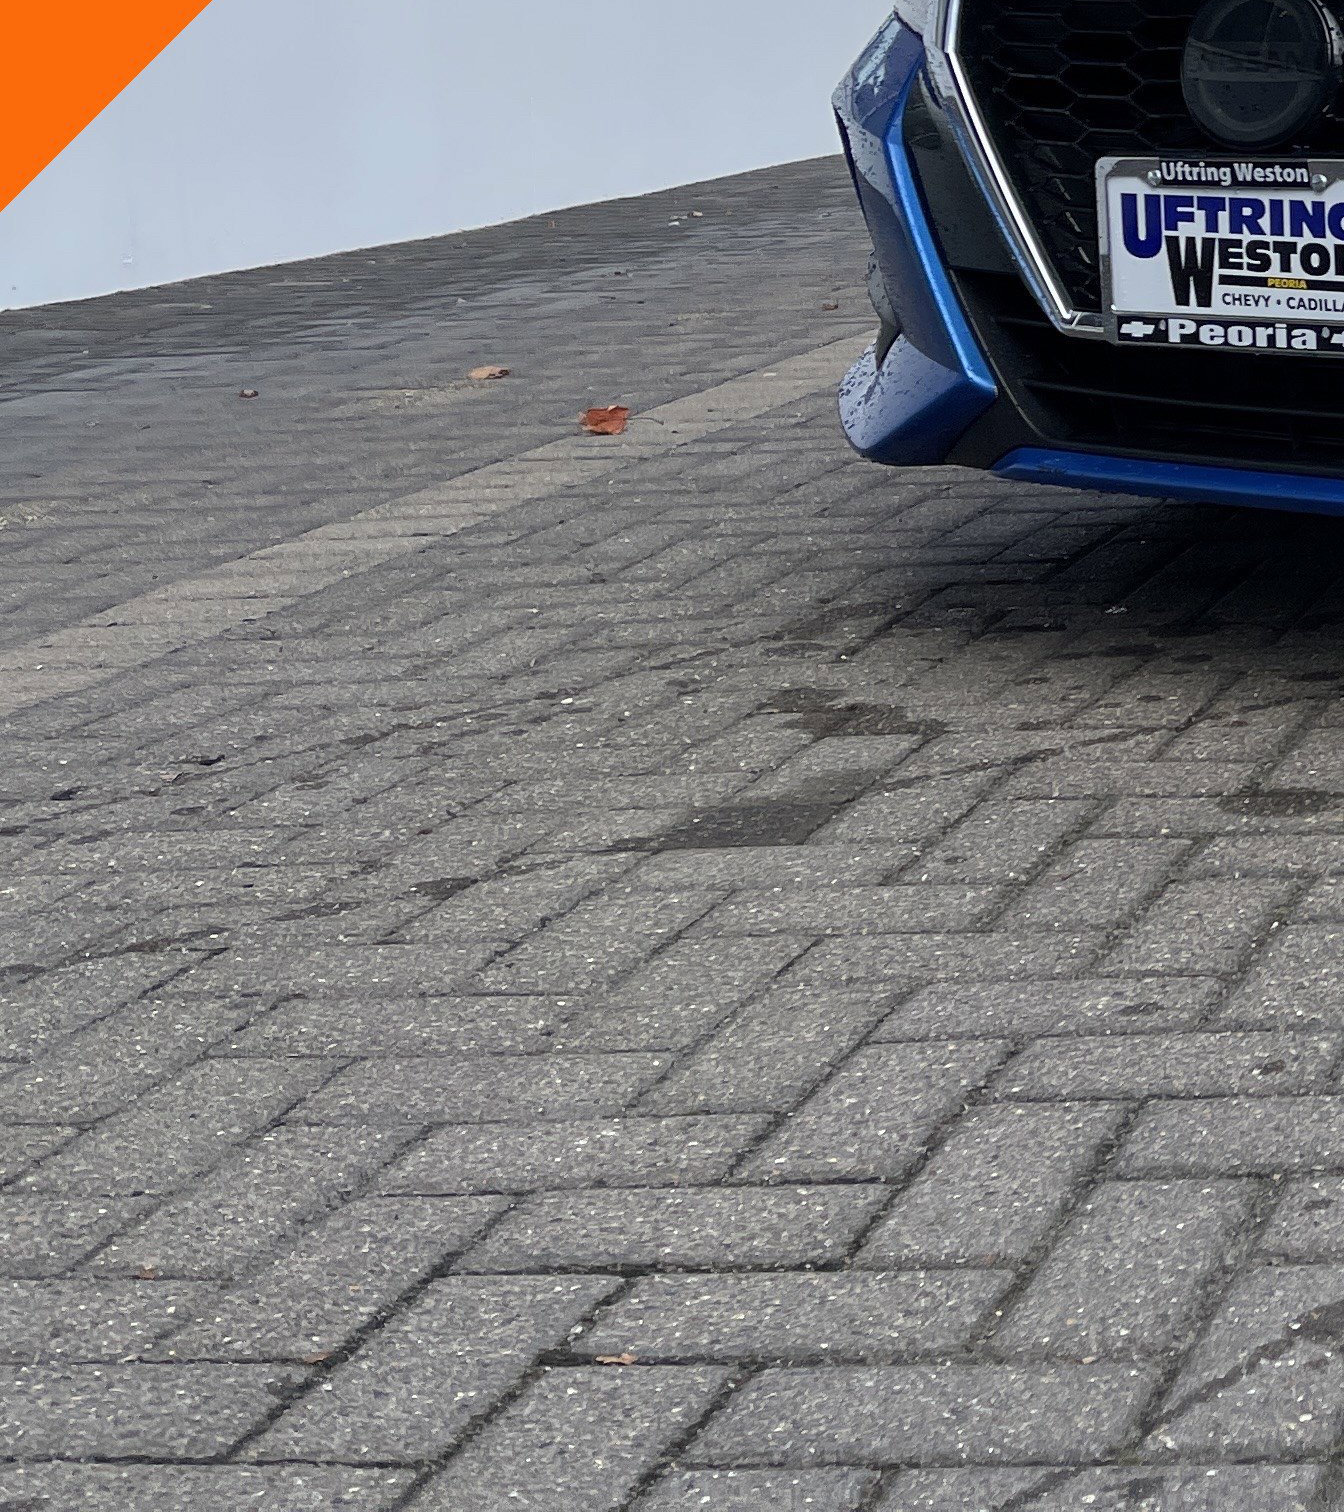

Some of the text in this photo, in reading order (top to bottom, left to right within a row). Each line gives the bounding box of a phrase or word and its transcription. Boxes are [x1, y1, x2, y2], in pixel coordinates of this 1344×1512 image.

[1161, 161, 1309, 186] Uftring Weston
[1267, 277, 1307, 289] PEORIA
[1222, 292, 1271, 308] CHEVY
[1168, 318, 1317, 350] Peoria
